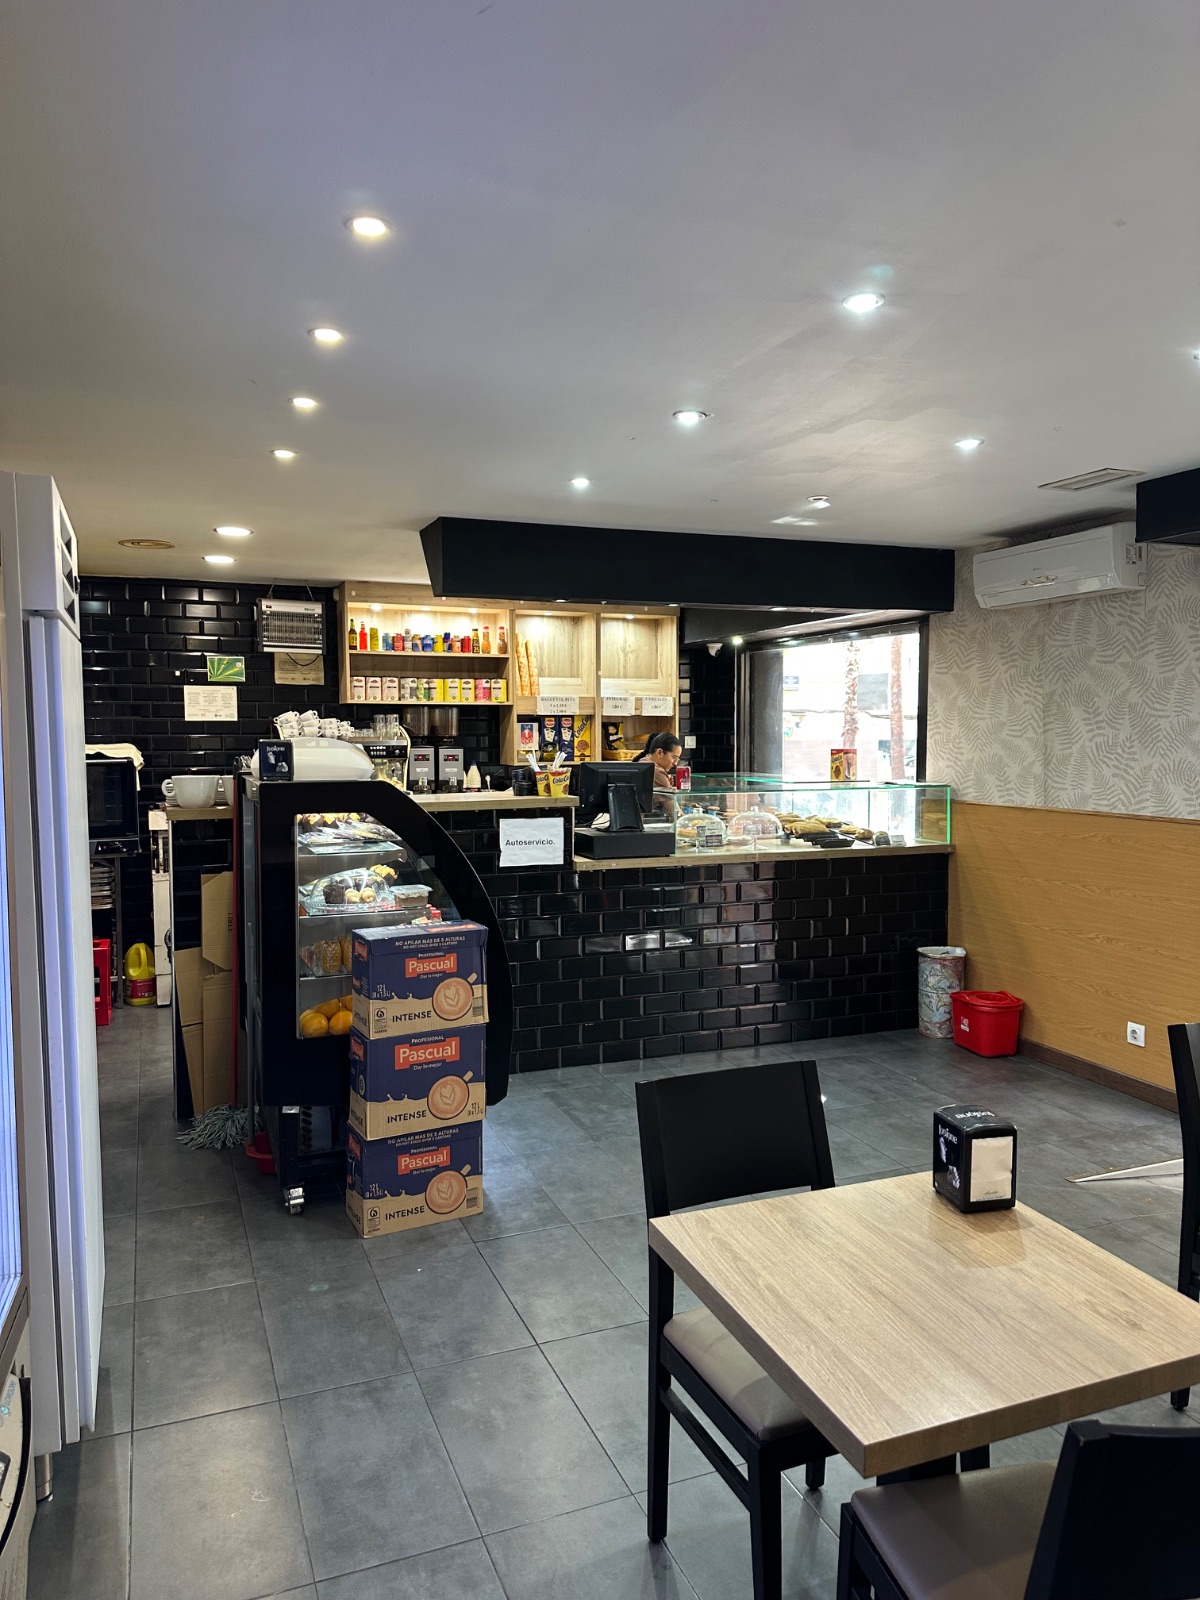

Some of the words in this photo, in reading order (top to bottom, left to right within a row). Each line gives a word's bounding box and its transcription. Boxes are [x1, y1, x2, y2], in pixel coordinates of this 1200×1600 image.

[505, 838, 556, 846] Autoservicio.
[409, 956, 454, 973] Pascual
[392, 1010, 432, 1023] INTENSE
[411, 1035, 444, 1044] PROFESIONAL
[400, 1041, 456, 1063] Pascual
[387, 1109, 427, 1124] INTENSE
[401, 1150, 447, 1170] Pascual
[385, 1205, 425, 1221] INTENSE
